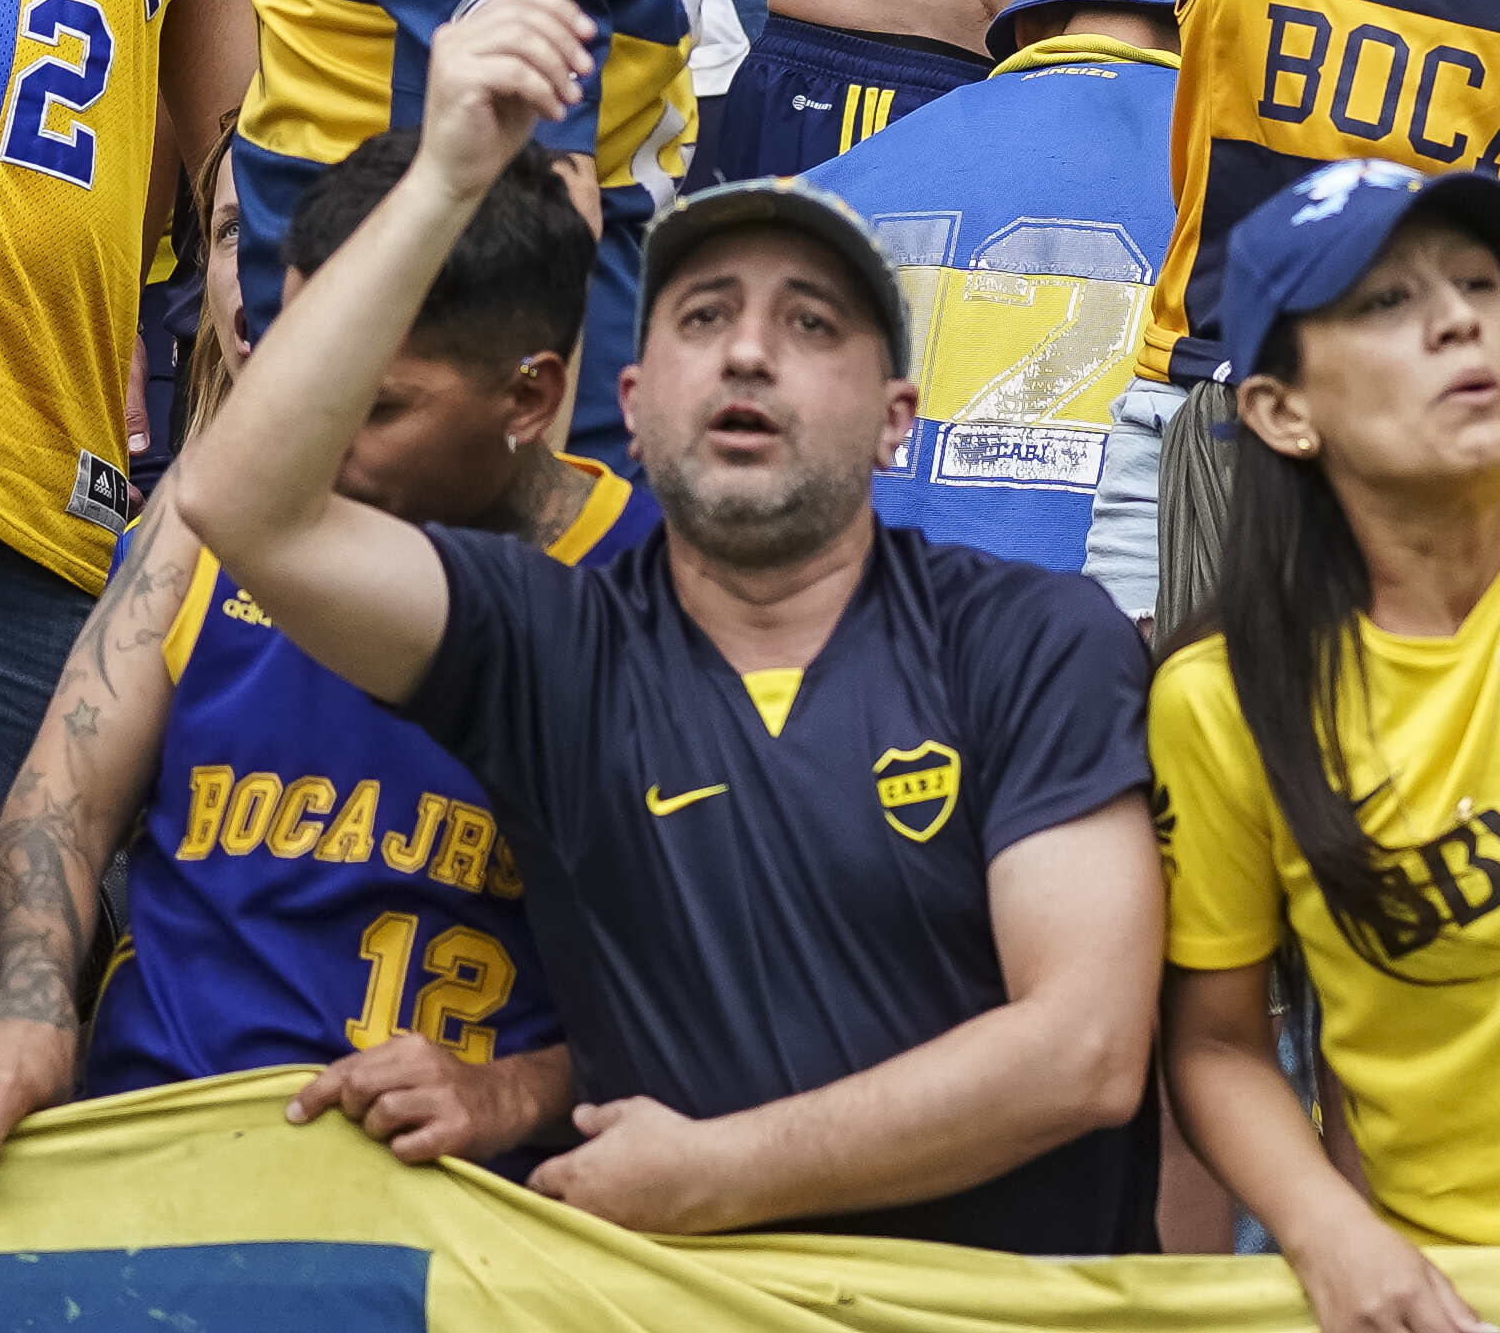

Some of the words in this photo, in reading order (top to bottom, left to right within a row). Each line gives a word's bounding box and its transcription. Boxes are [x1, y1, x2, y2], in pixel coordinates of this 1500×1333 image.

[175, 765, 381, 863] BOCA
[886, 774, 946, 800] CABJ
[345, 911, 517, 1065] 12
